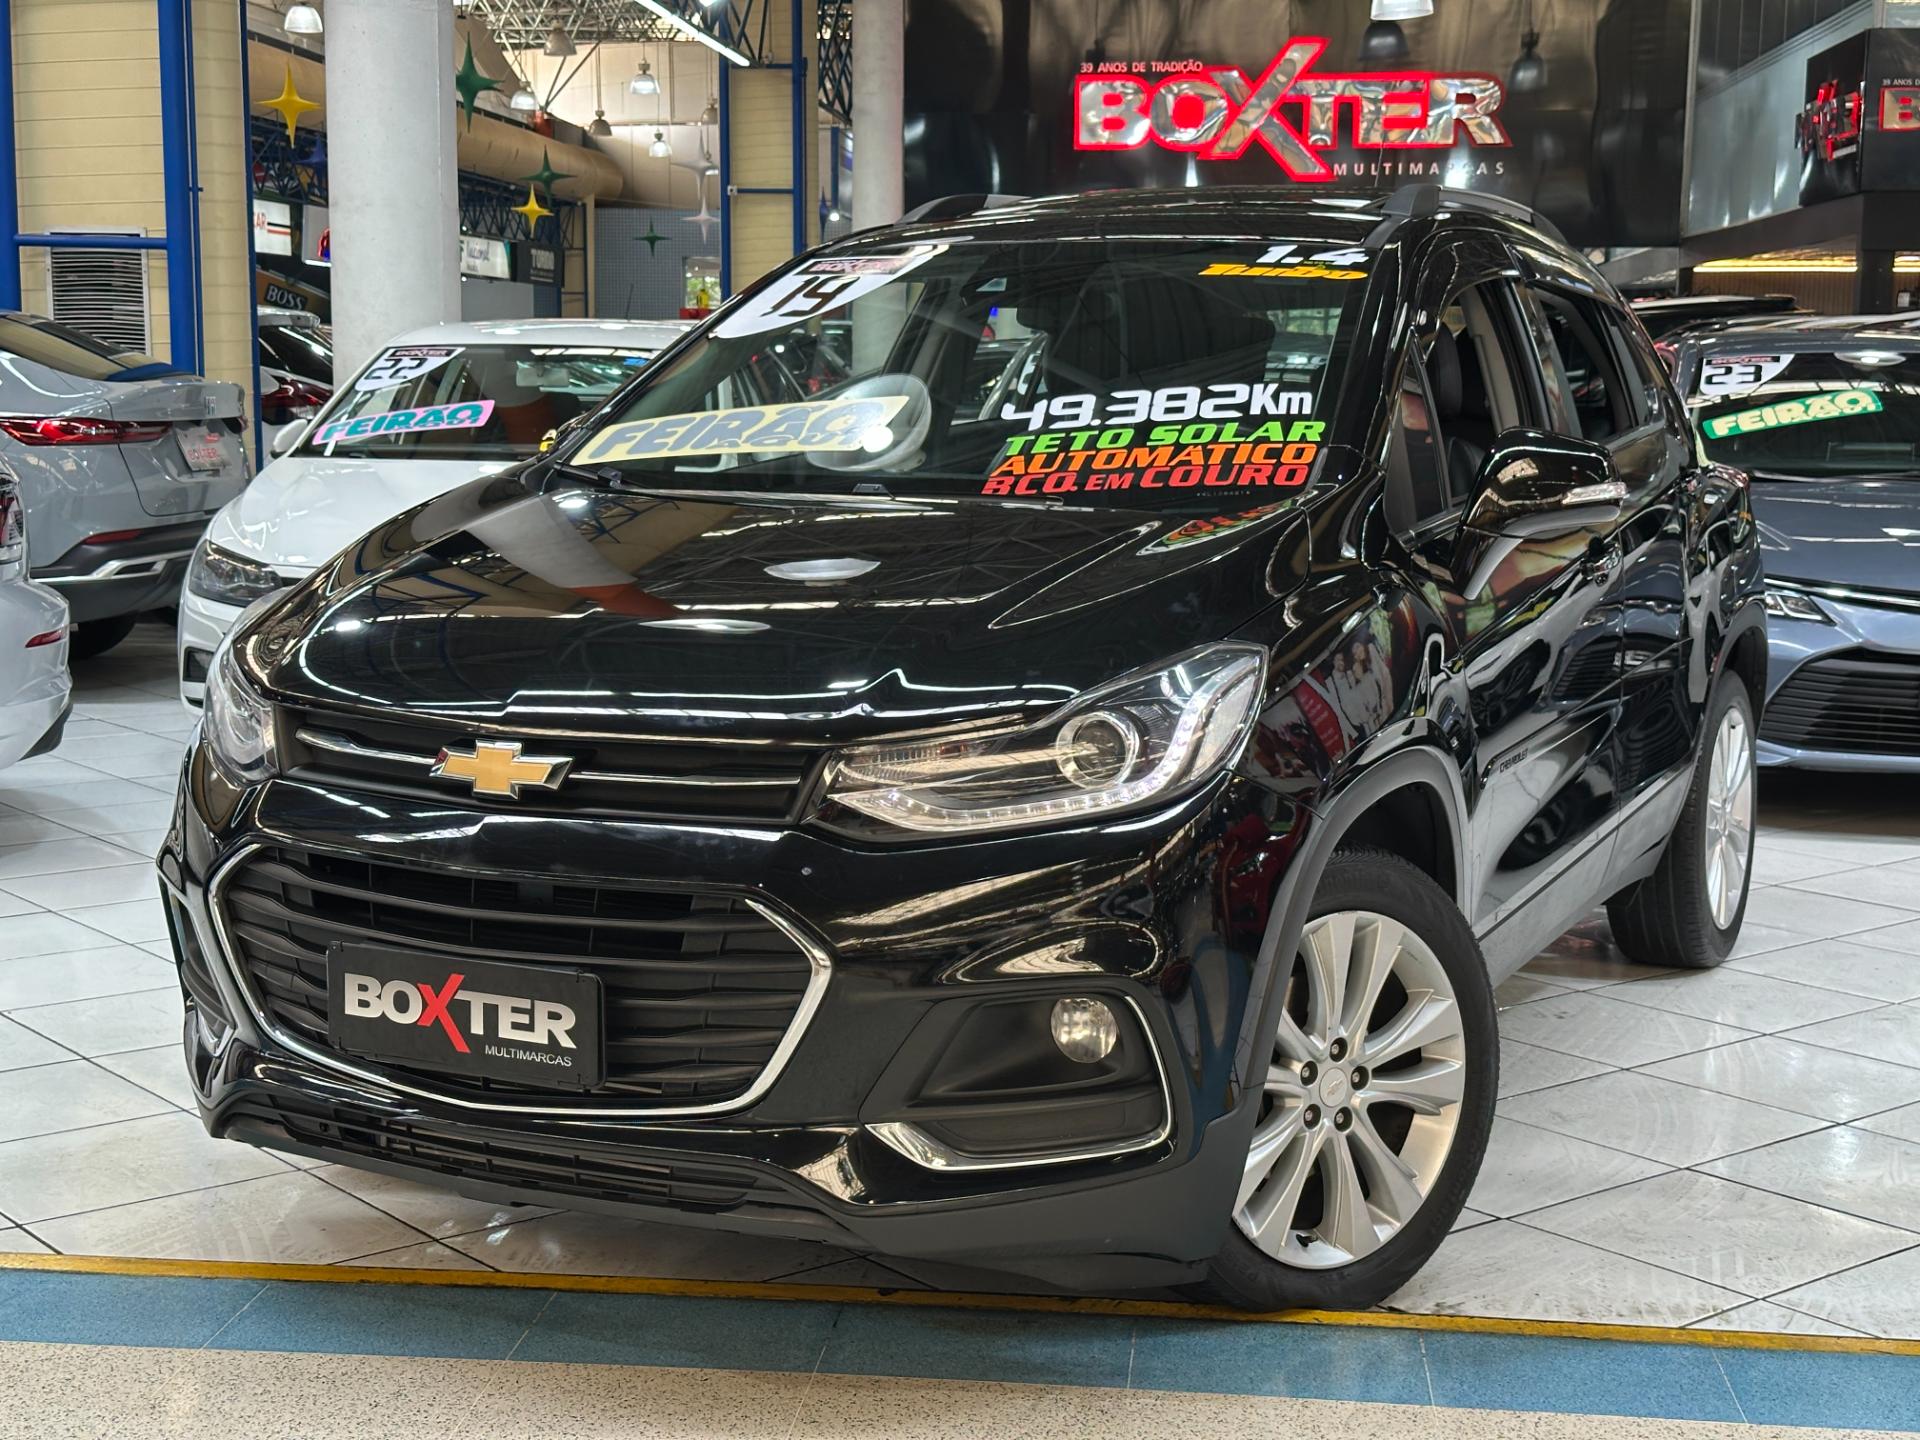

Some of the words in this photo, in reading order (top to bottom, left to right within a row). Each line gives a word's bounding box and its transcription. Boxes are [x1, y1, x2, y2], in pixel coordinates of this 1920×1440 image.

[1080, 62, 1093, 73] 39
[1098, 62, 1128, 73] ANOS
[1132, 62, 1146, 72] DE
[1151, 59, 1203, 74] TRADIÇÃO
[1074, 36, 1513, 182] BOXTER
[1333, 162, 1505, 176] MULTIMAAS
[1255, 244, 1370, 266] 1.4
[266, 285, 304, 310] BOSS
[760, 275, 860, 317] 19
[363, 357, 428, 380] 22
[1704, 364, 1763, 386] 23
[1711, 391, 1876, 436] FEIRÃO
[1005, 428, 1134, 456] TETO
[1147, 421, 1325, 446] SOLAR
[1085, 473, 1134, 491] EM
[1139, 464, 1309, 488] COURO
[344, 972, 577, 1054] BOXTER
[485, 1044, 573, 1067] MULTIMARCAS
